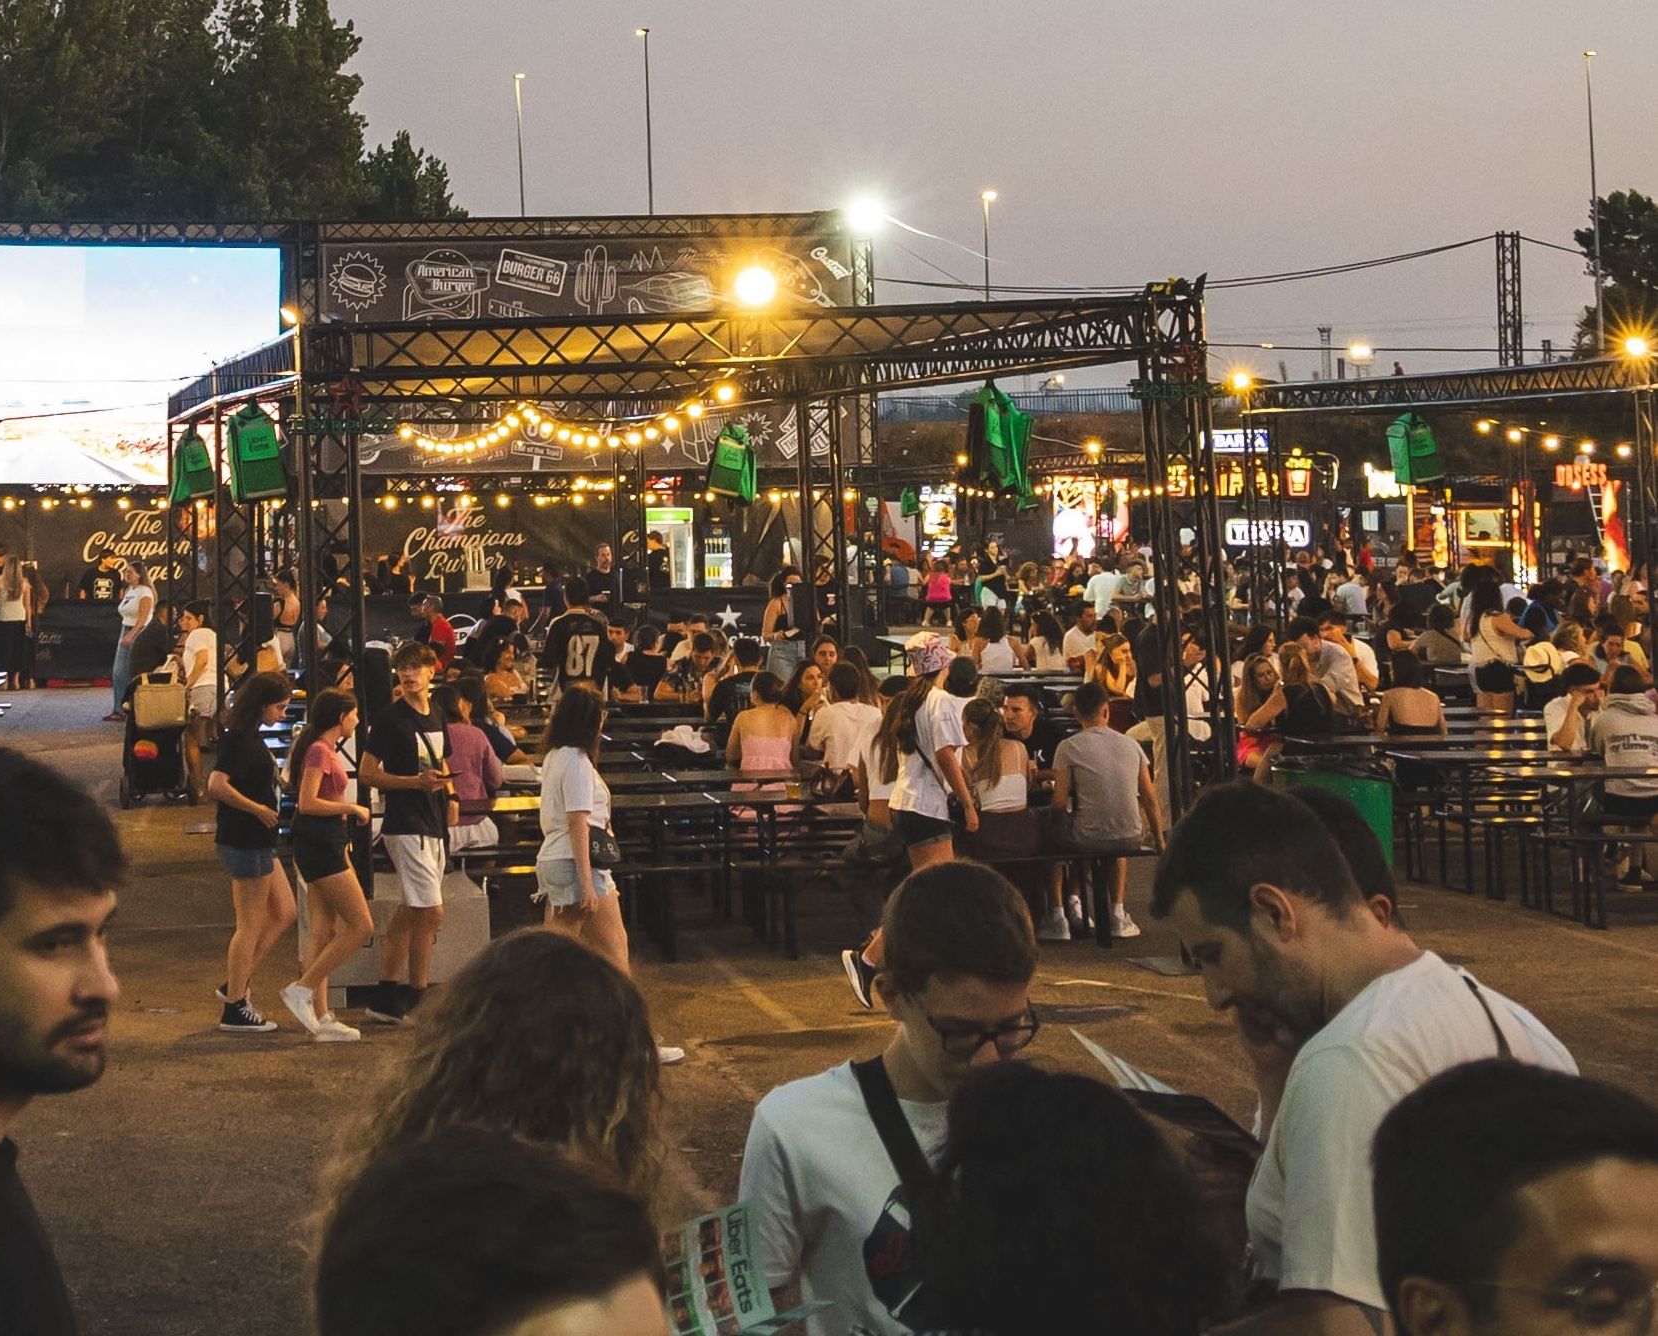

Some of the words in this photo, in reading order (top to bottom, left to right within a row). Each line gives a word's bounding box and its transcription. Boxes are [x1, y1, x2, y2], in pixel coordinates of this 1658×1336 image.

[417, 264, 474, 278] American
[431, 278, 475, 293] Burger
[502, 259, 545, 282] BURGER
[545, 269, 561, 286] 66
[499, 305, 531, 318] ILLIN
[122, 509, 164, 540] The
[445, 505, 487, 533] The
[83, 531, 193, 563] Champin
[403, 526, 526, 559] Champions
[114, 557, 183, 585] Bger
[424, 551, 506, 580] Burer
[565, 634, 600, 677] 87
[726, 1208, 744, 1255] Uber
[731, 1259, 753, 1314] Eats
